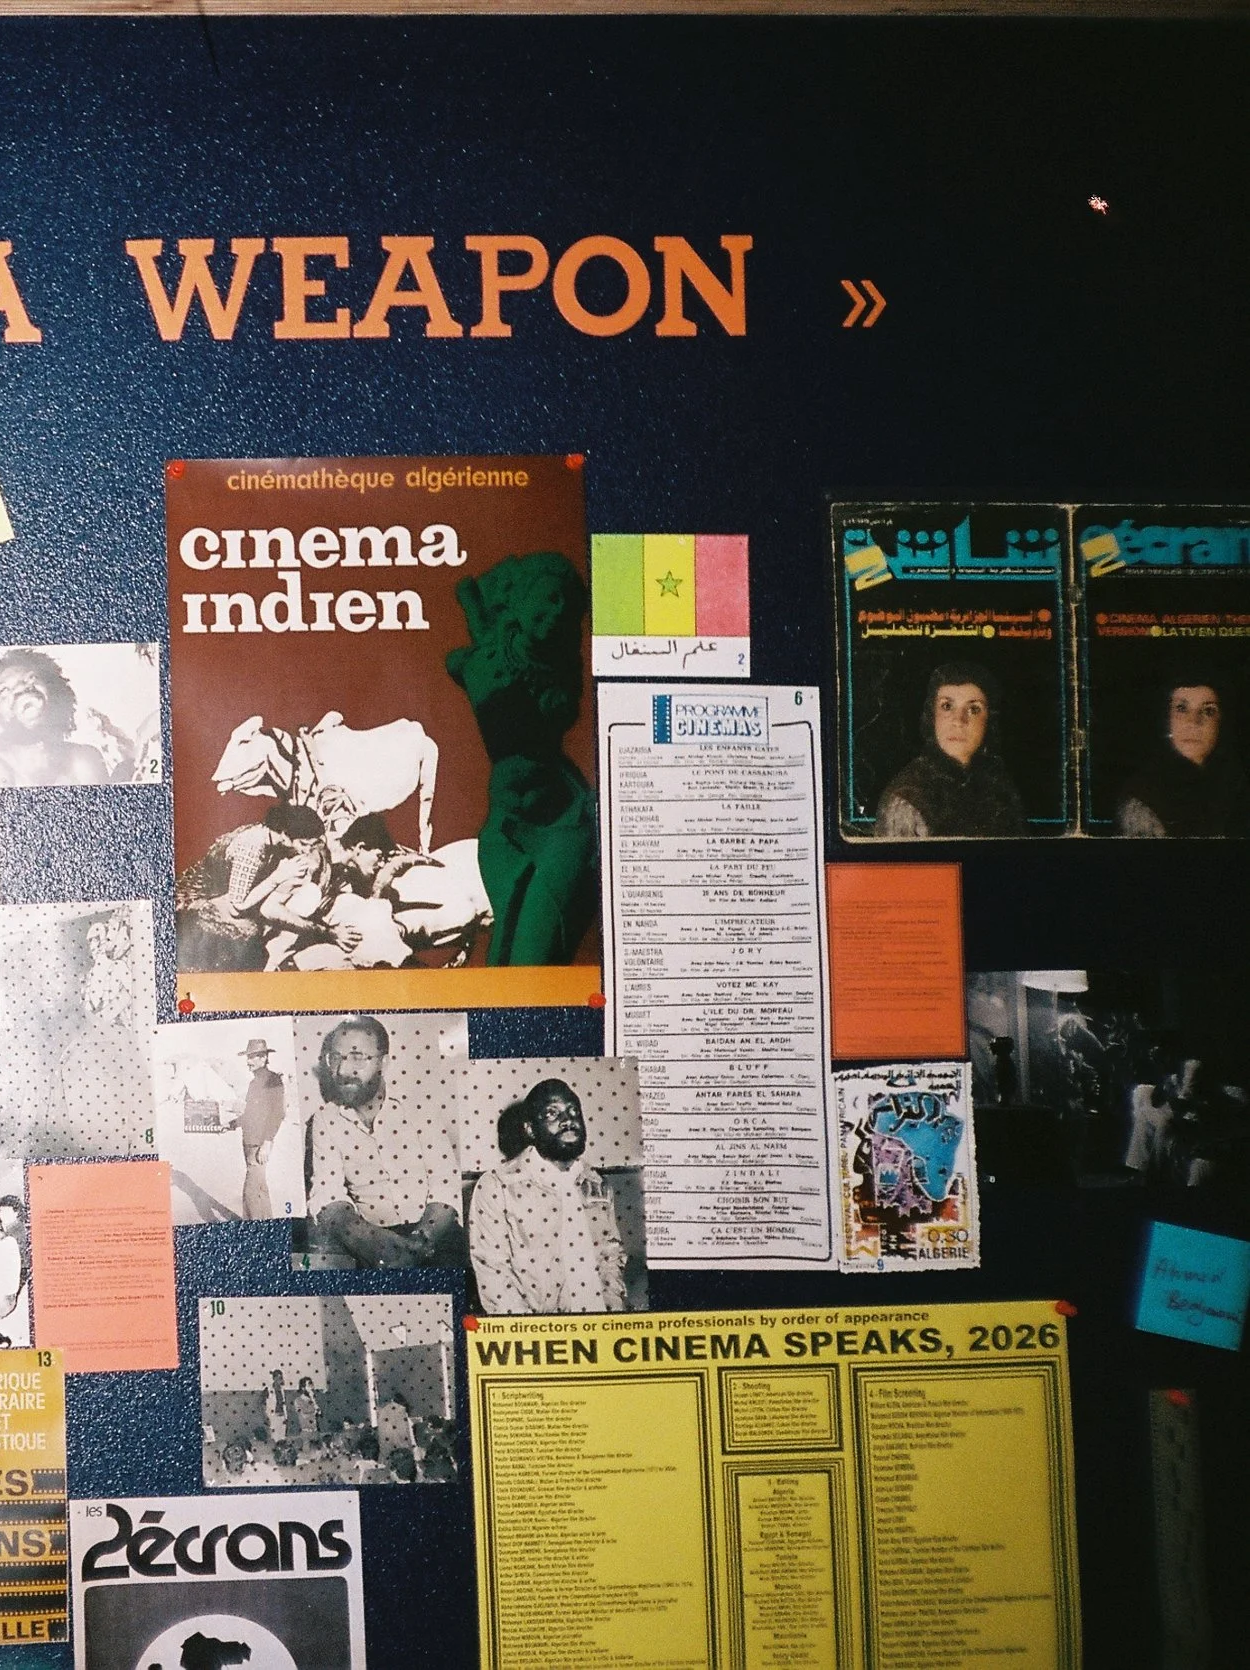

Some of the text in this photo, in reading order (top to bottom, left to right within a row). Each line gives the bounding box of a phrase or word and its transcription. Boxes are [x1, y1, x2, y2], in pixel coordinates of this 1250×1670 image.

[125, 234, 753, 340] WEAPON
[227, 466, 530, 493] cinémathèque algérienne
[179, 523, 467, 570] cinema
[181, 570, 430, 633] indien
[794, 691, 803, 706] 6
[676, 704, 763, 719] PROGRAMME
[676, 719, 762, 737] CINEMAS
[149, 758, 159, 774] 2
[284, 1201, 292, 1214] 3
[918, 1247, 969, 1260] ALGERIE
[510, 1321, 578, 1333] directors
[583, 1322, 598, 1332] or
[602, 1320, 654, 1331] cinema
[659, 1315, 754, 1332] professionals
[760, 1315, 776, 1328] by
[782, 1314, 820, 1325] order
[825, 1312, 839, 1324] of
[845, 1310, 929, 1325] appearance
[475, 1323, 1060, 1366] WHEN CINEMA SPEAKS, 2026
[37, 1352, 52, 1367] 13
[85, 1505, 103, 1518] les
